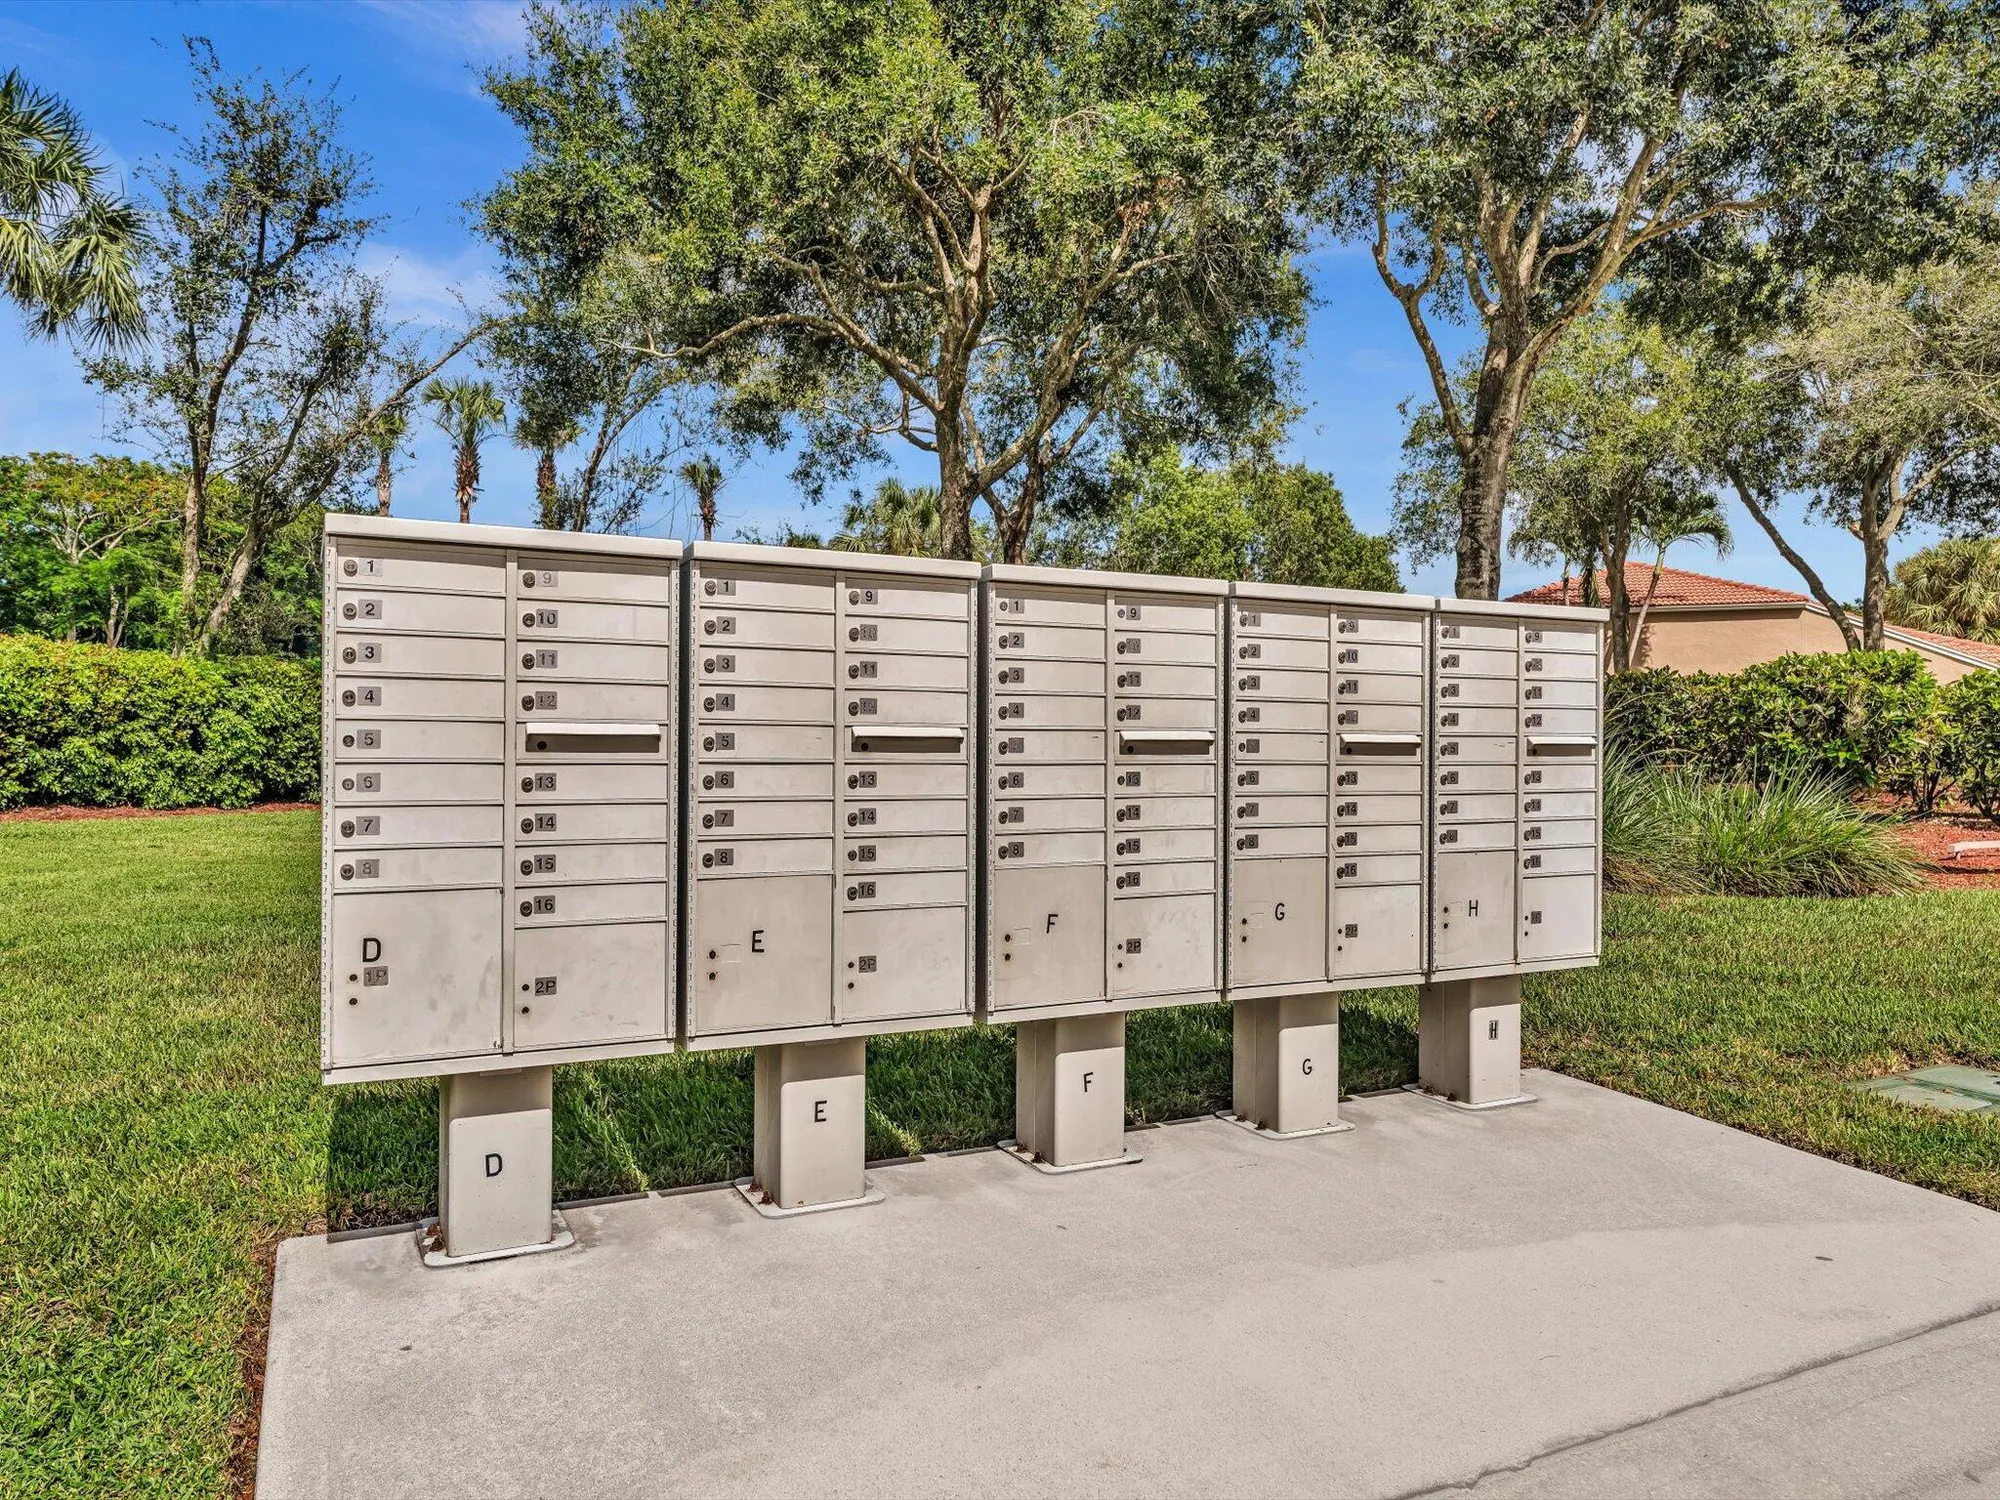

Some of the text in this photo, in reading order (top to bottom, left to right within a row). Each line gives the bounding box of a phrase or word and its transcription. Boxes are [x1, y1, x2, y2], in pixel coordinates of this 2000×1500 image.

[366, 559, 374, 573] 1
[542, 572, 552, 585] 9
[723, 580, 729, 592] 1
[865, 590, 873, 602] 9
[364, 602, 376, 616] 2
[1130, 608, 1137, 618] 9
[538, 612, 556, 625] 10
[722, 620, 730, 632] 2
[1348, 621, 1355, 631] 9
[1013, 635, 1020, 646] 2
[364, 646, 375, 660] 3
[1251, 646, 1257, 656] 2
[1347, 652, 1358, 661] 10
[539, 653, 555, 666] 11
[722, 658, 730, 670] 3
[862, 664, 876, 674] 11
[1012, 670, 1020, 680] 3
[1128, 674, 1140, 684] 11
[1251, 677, 1256, 688] 3
[364, 689, 375, 703] 4
[721, 696, 729, 708] 4
[1012, 704, 1020, 715] 4
[1127, 707, 1140, 718] 12
[364, 732, 374, 746] 5
[721, 736, 729, 748] 5
[363, 776, 374, 789] 6
[537, 776, 554, 789] 13
[720, 774, 729, 786] 6
[860, 774, 875, 786] 13
[1012, 775, 1020, 786] 6
[1127, 774, 1139, 784] 13
[1346, 773, 1357, 783] 13
[1013, 810, 1019, 820] 7
[1128, 808, 1139, 818] 14
[1346, 804, 1356, 814] 14
[537, 816, 555, 829] 14
[720, 812, 728, 824] 7
[860, 811, 875, 822] 14
[363, 819, 374, 832] 7
[1012, 844, 1020, 856] 8
[1128, 841, 1139, 851] 15
[720, 851, 728, 863] 8
[860, 848, 874, 859] 15
[362, 862, 372, 876] 8
[536, 858, 554, 871] 15
[1345, 865, 1356, 874] 16
[1127, 874, 1139, 884] 16
[860, 884, 874, 896] 16
[536, 898, 554, 911] 16
[1468, 900, 1479, 917] H
[1274, 902, 1285, 921] G
[1046, 913, 1058, 934] F
[752, 929, 765, 953] E
[1126, 940, 1141, 952] 2P
[362, 938, 382, 963] D
[859, 958, 876, 970] 2P
[536, 979, 556, 994] 2P
[1490, 1021, 1498, 1040] H
[1302, 1058, 1312, 1076] G
[1083, 1072, 1094, 1092] F
[814, 1099, 828, 1123] E
[485, 1152, 502, 1178] D
